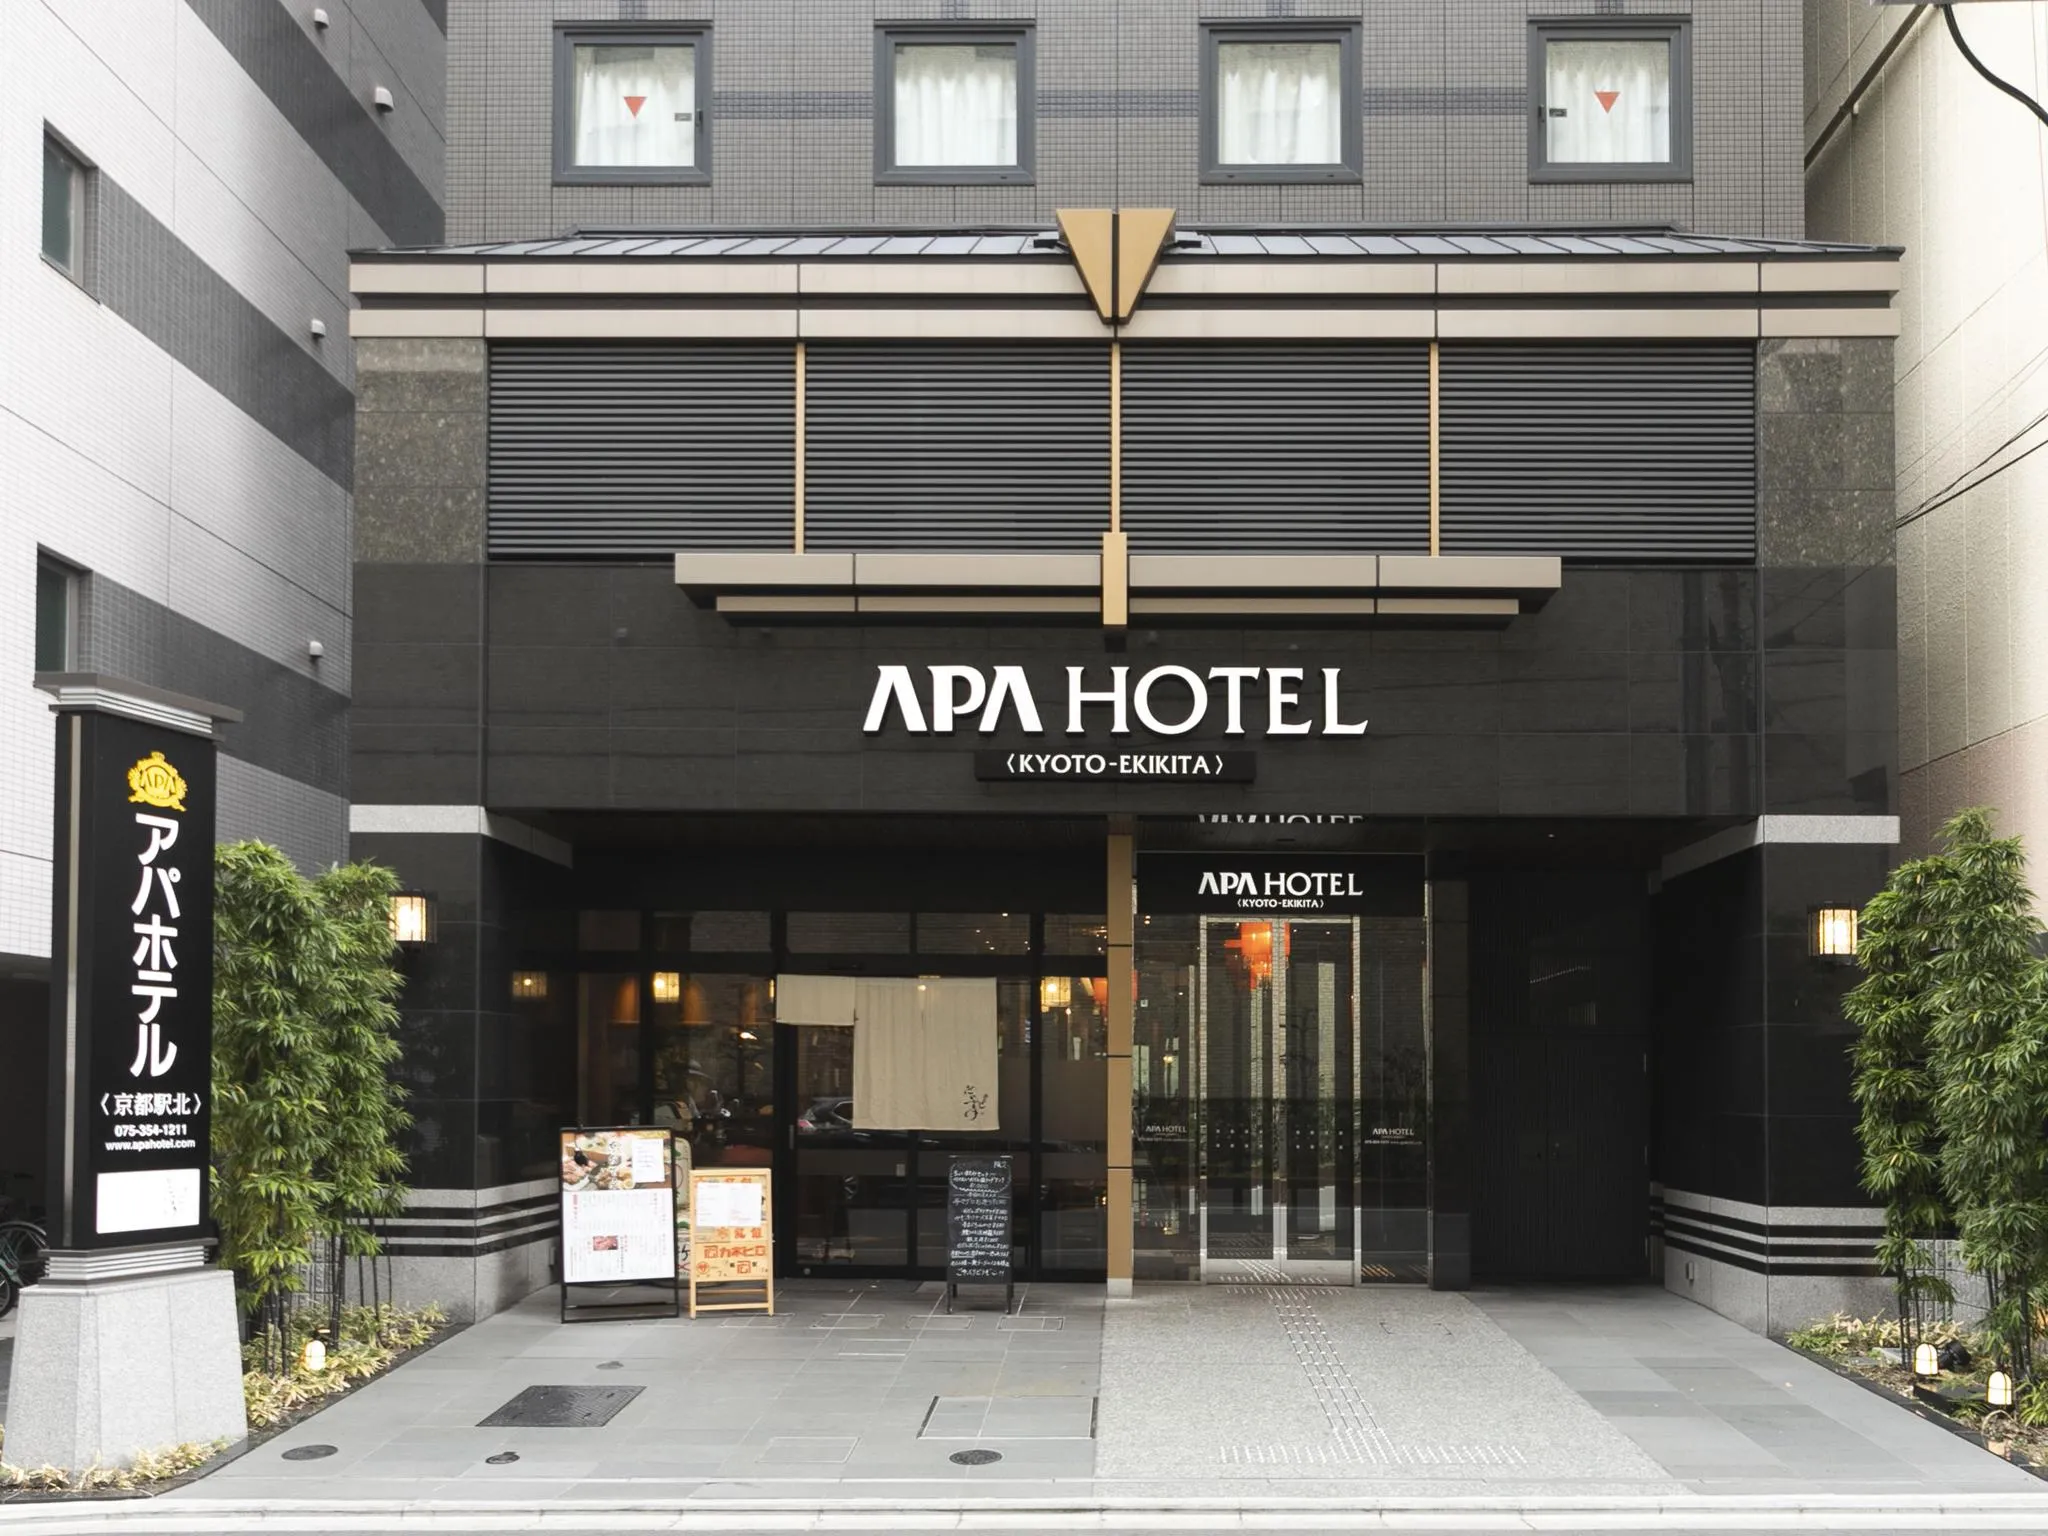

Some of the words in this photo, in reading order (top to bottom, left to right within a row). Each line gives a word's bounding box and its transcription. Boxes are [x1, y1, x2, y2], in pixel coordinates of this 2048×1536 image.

[863, 666, 1043, 731] APA
[1066, 665, 1368, 734] HOTEL
[1199, 872, 1257, 895] APA
[1265, 872, 1363, 896] HOTEL
[130, 813, 180, 1077] アパホテル
[114, 1124, 187, 1137] 075-354-1211
[105, 1139, 195, 1152] www.apahotel.com
